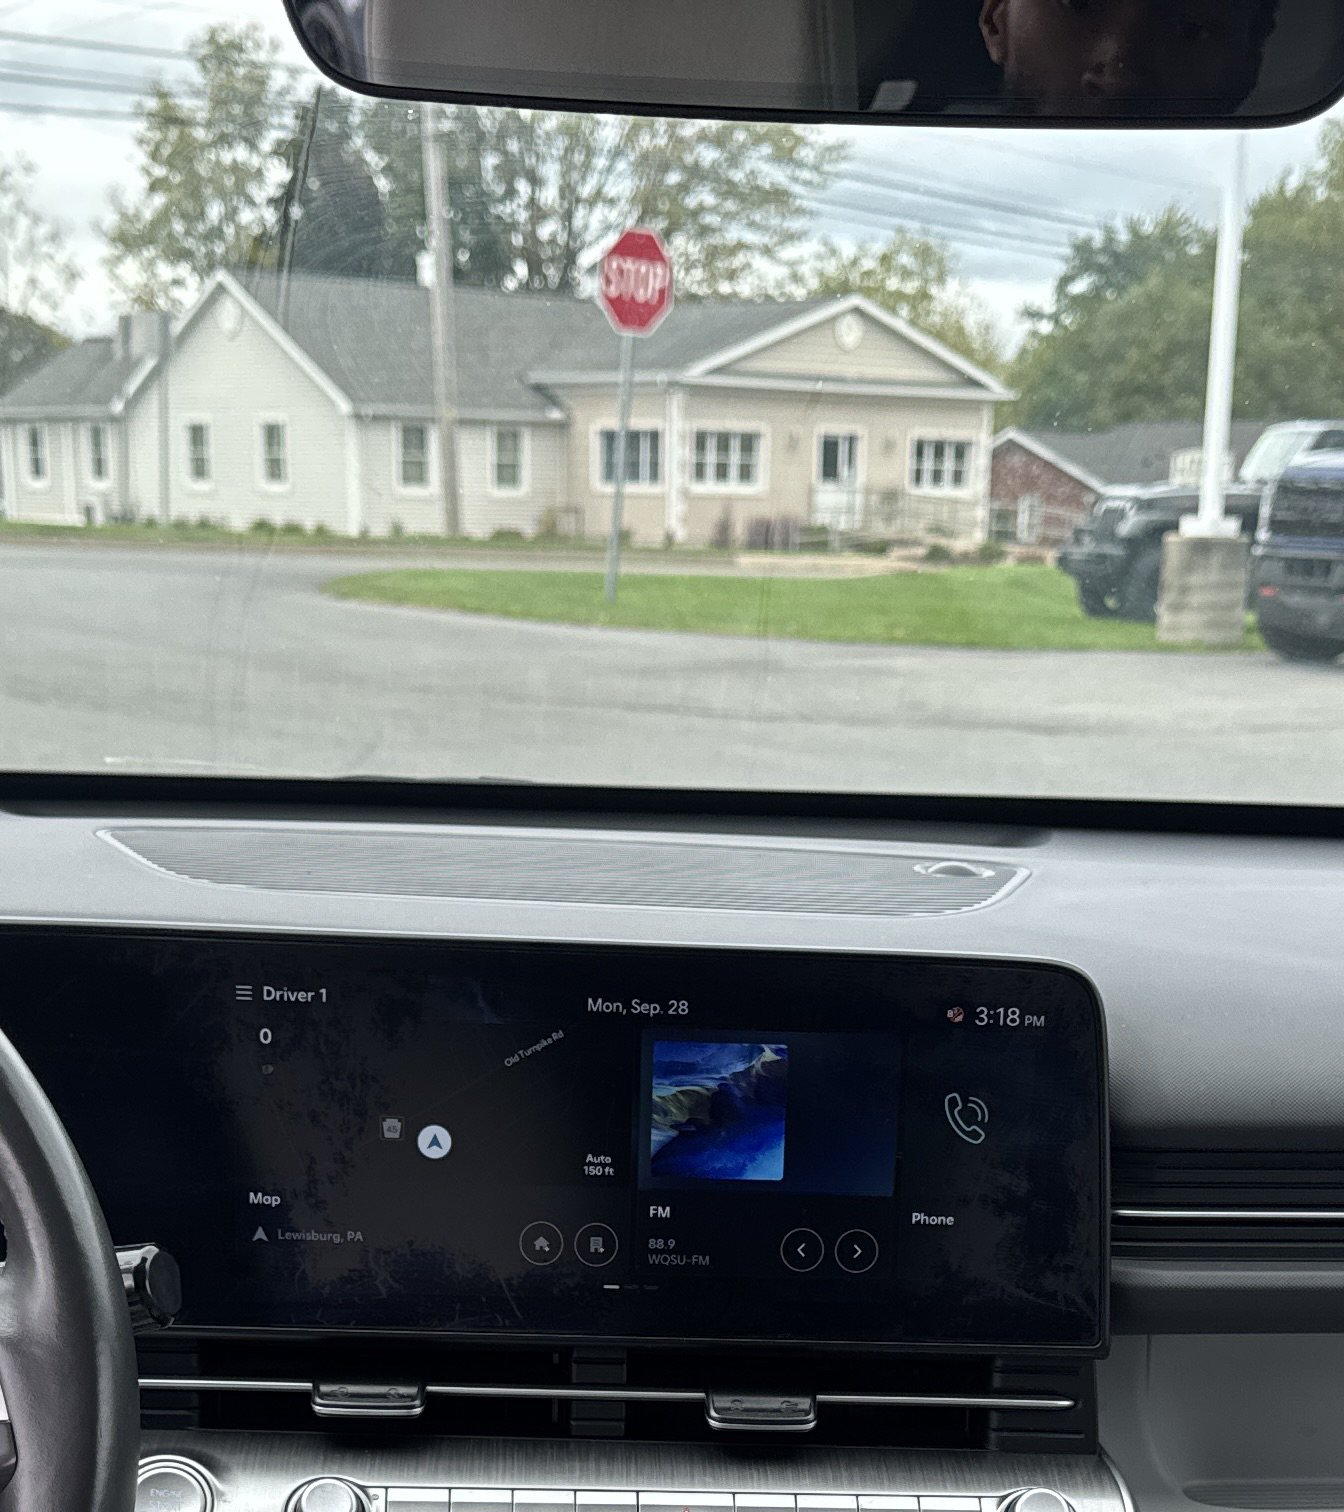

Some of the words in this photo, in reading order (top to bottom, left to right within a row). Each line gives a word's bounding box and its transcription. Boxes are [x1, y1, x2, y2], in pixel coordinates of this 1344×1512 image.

[606, 256, 667, 304] STOP
[262, 985, 315, 1003] Driver
[319, 988, 327, 1003] 1
[587, 997, 627, 1016] Mon,
[630, 998, 664, 1018] Sep.
[667, 999, 689, 1015] 28
[974, 1006, 1020, 1027] 3:18
[1024, 1015, 1045, 1027] PM
[259, 1027, 272, 1045] 0
[504, 1053, 520, 1067] Old
[551, 1029, 564, 1041] Rd
[585, 1153, 612, 1164] Auto
[583, 1165, 603, 1176] 150
[604, 1166, 614, 1176] ft
[249, 1191, 281, 1208] Map
[649, 1205, 671, 1218] FM
[911, 1211, 955, 1227] Phone
[277, 1229, 345, 1244] Lewisburg,
[347, 1231, 364, 1243] PA
[647, 1238, 676, 1250] 88.9
[647, 1254, 710, 1266] WQSU-FM
